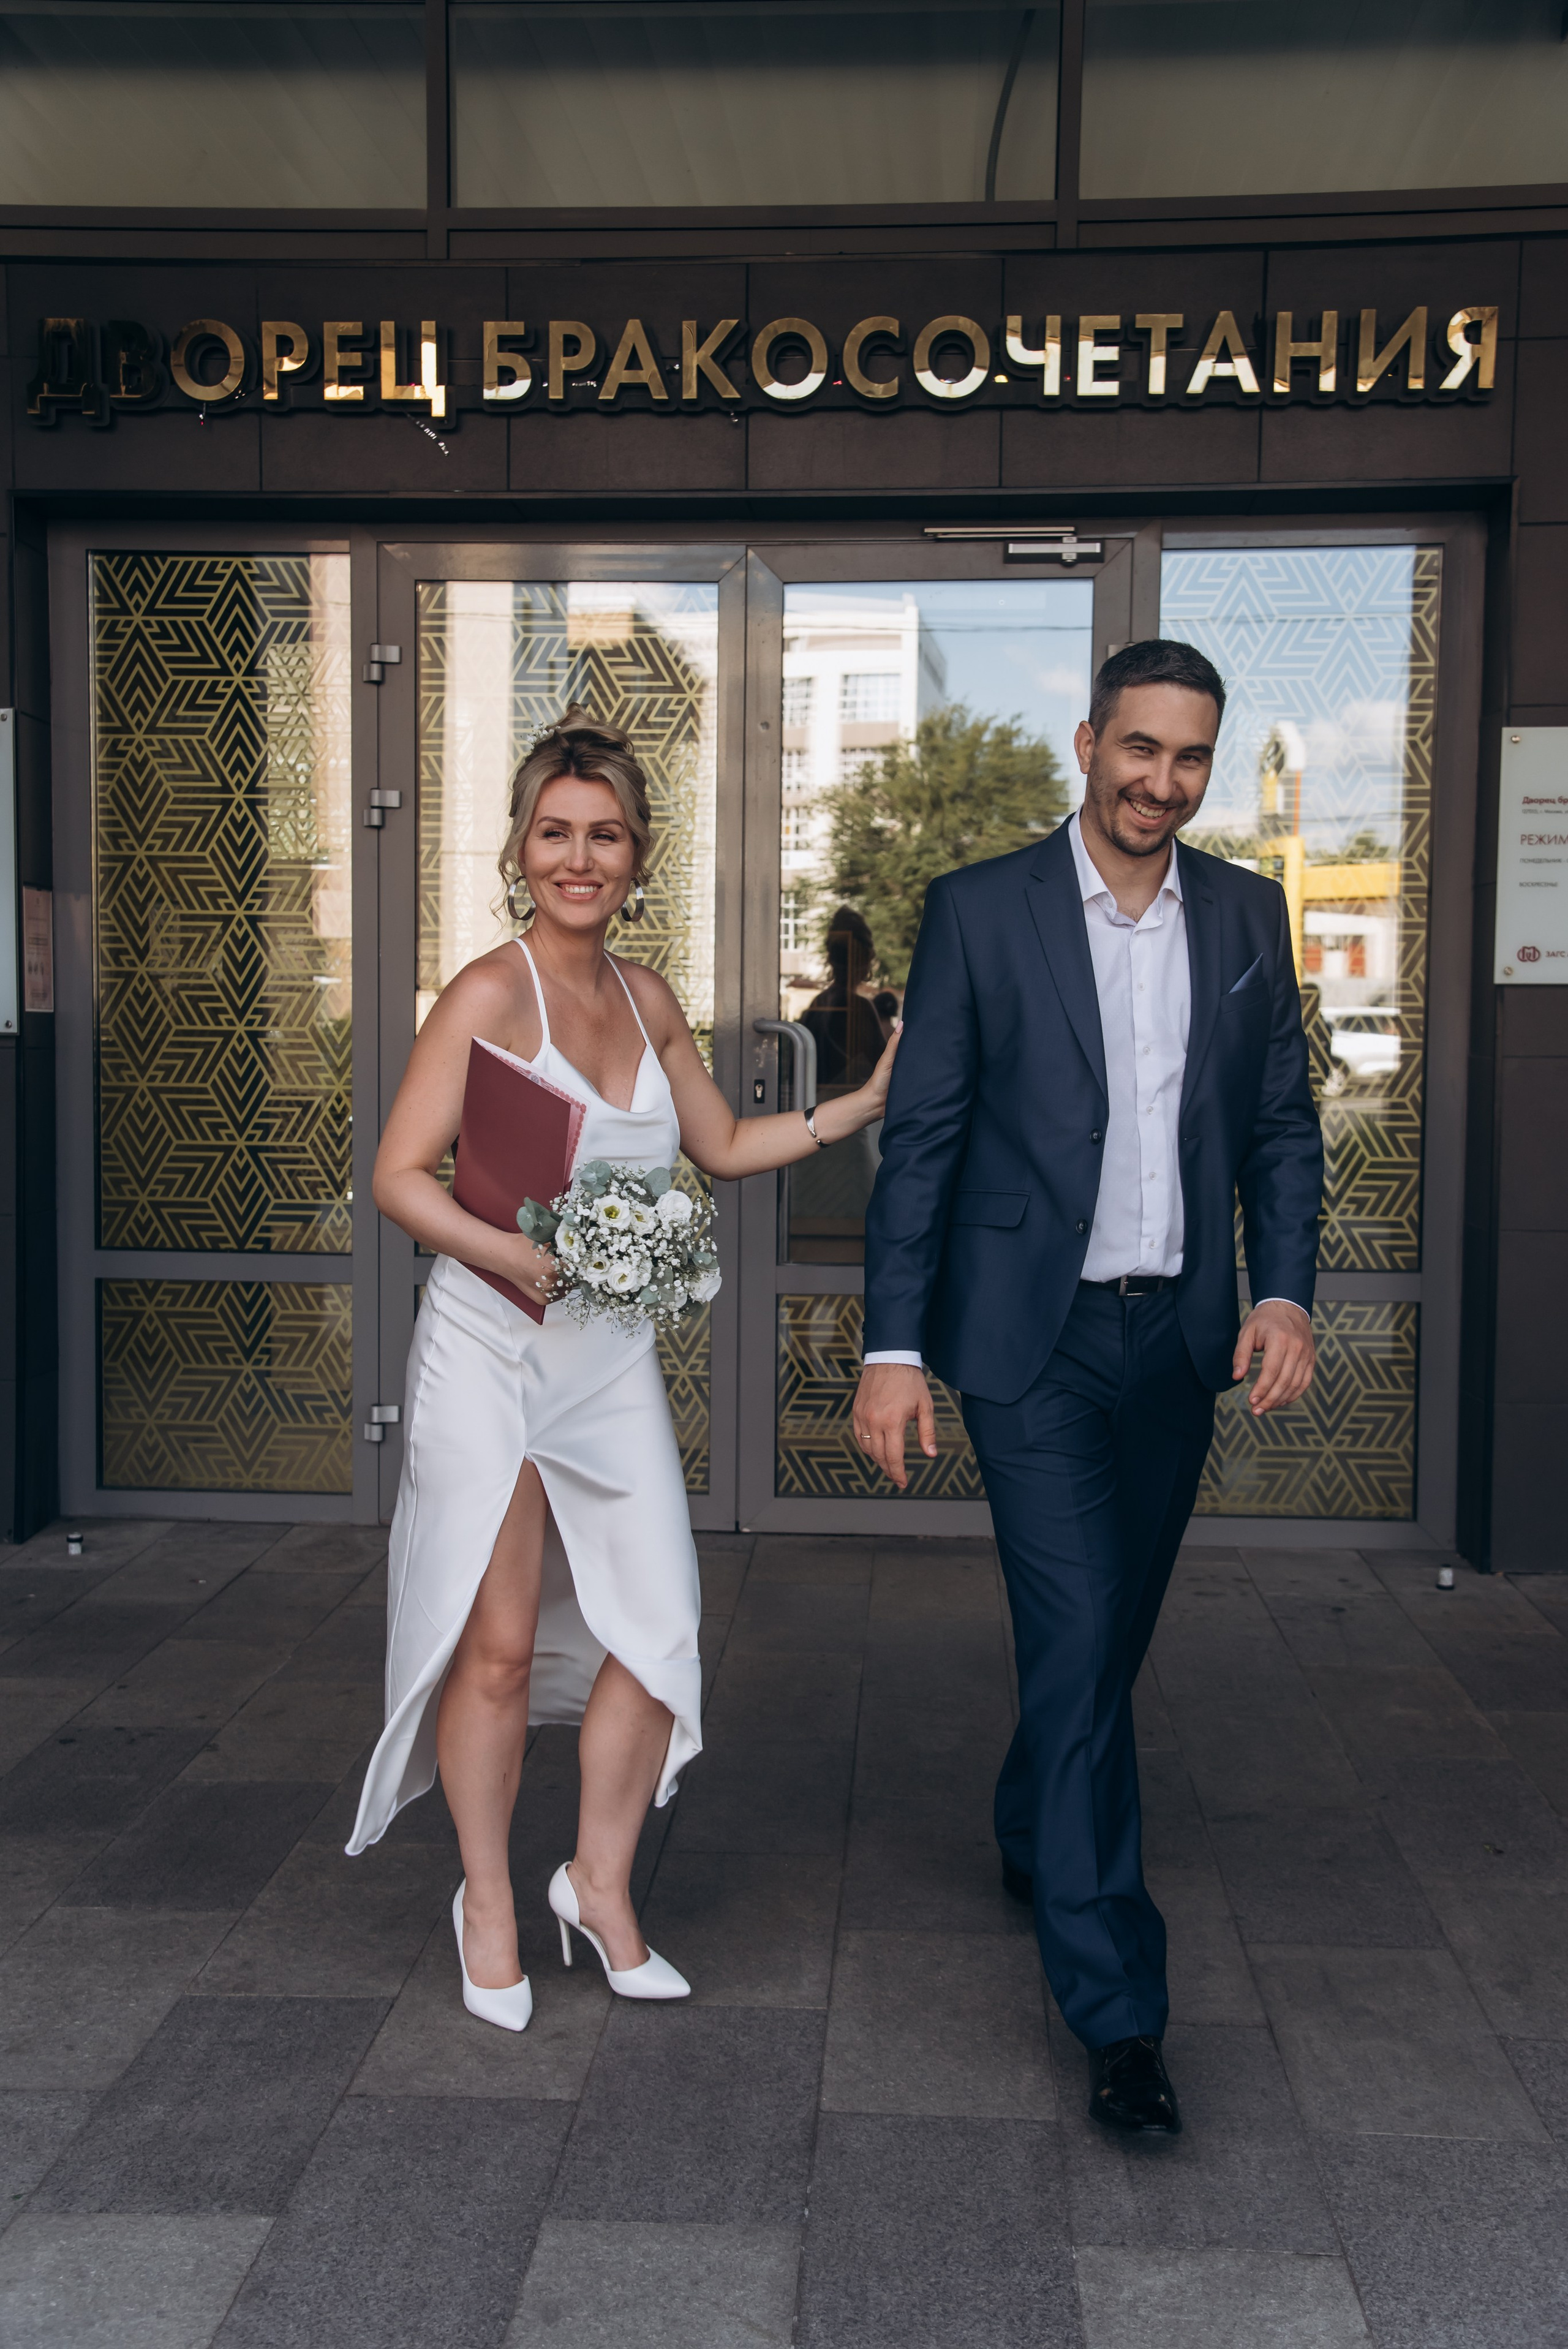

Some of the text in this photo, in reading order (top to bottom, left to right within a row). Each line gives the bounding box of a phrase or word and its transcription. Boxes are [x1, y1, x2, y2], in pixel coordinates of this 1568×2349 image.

[28, 306, 1499, 417] ДВОРЕЦ БРАКОСОЧЕТАНИЯ
[1521, 796, 1556, 805] Дворец
[1520, 834, 1568, 845] РЕЖИМ
